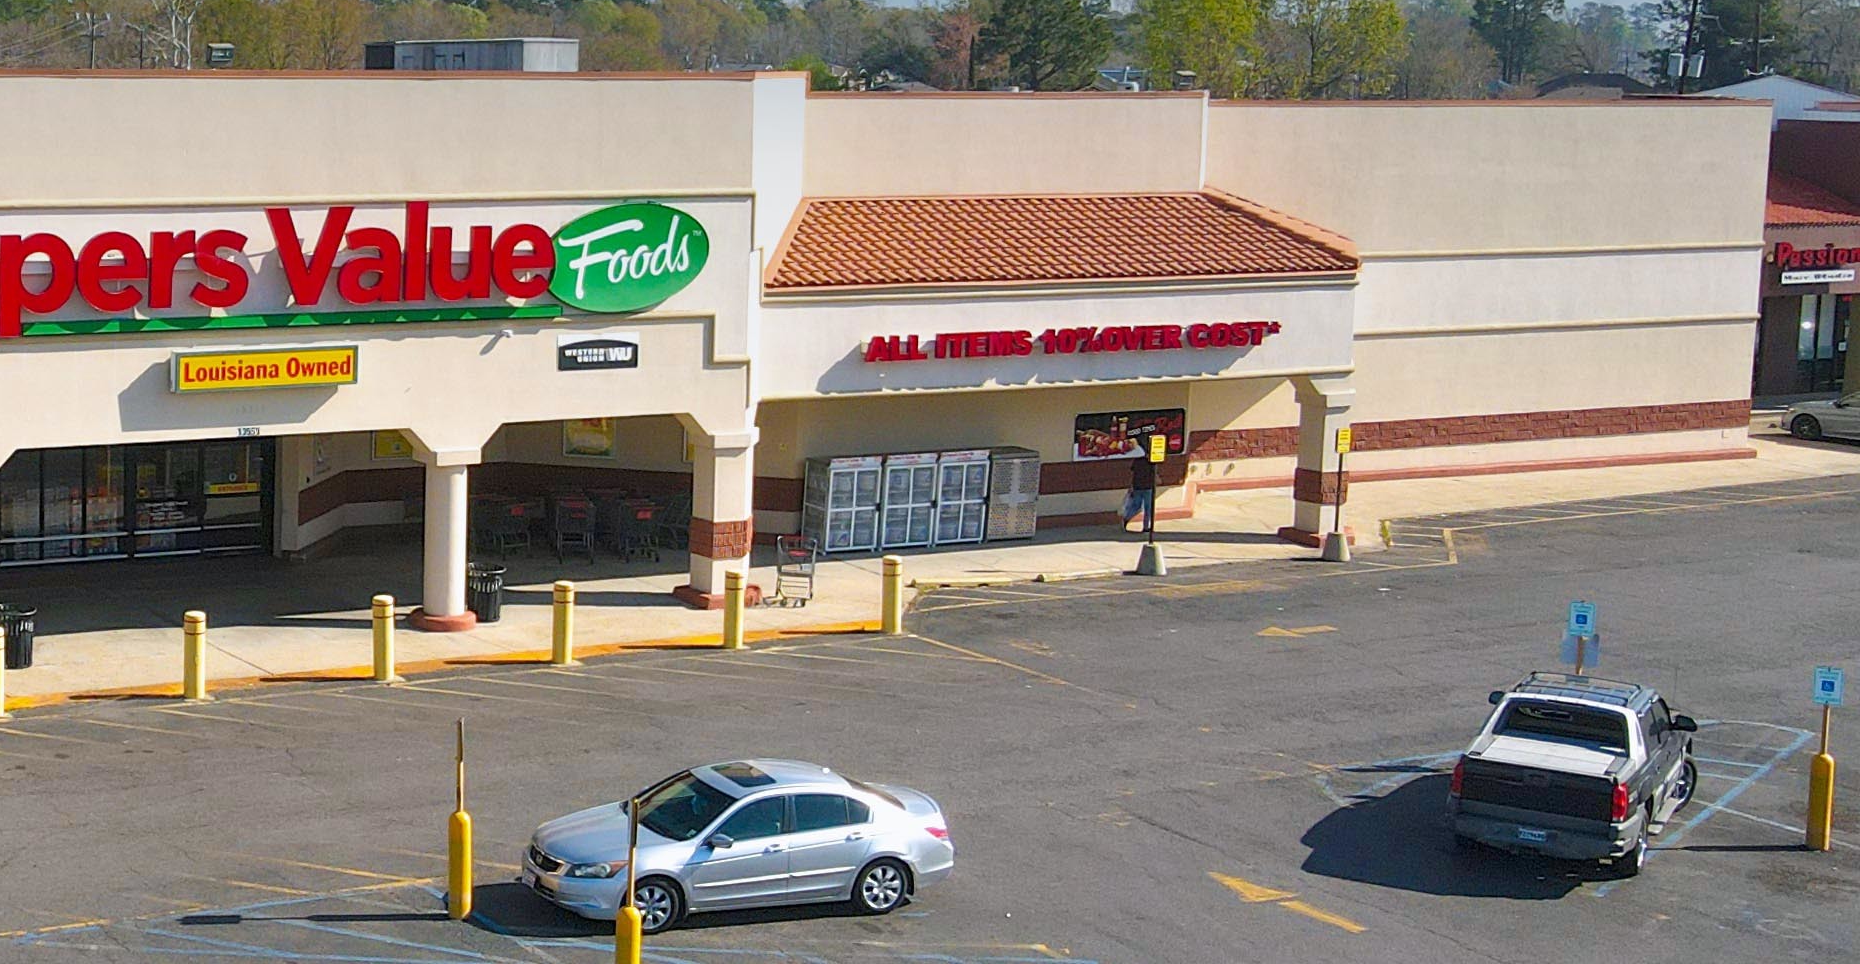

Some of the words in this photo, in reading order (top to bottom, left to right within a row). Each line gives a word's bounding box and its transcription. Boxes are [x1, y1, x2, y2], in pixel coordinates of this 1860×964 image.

[265, 201, 556, 305] Value
[558, 215, 690, 299] Foods
[865, 335, 927, 362] ALL
[934, 331, 1033, 359] ITEMS
[184, 359, 279, 383] Louisiana
[286, 355, 352, 378] Owned
